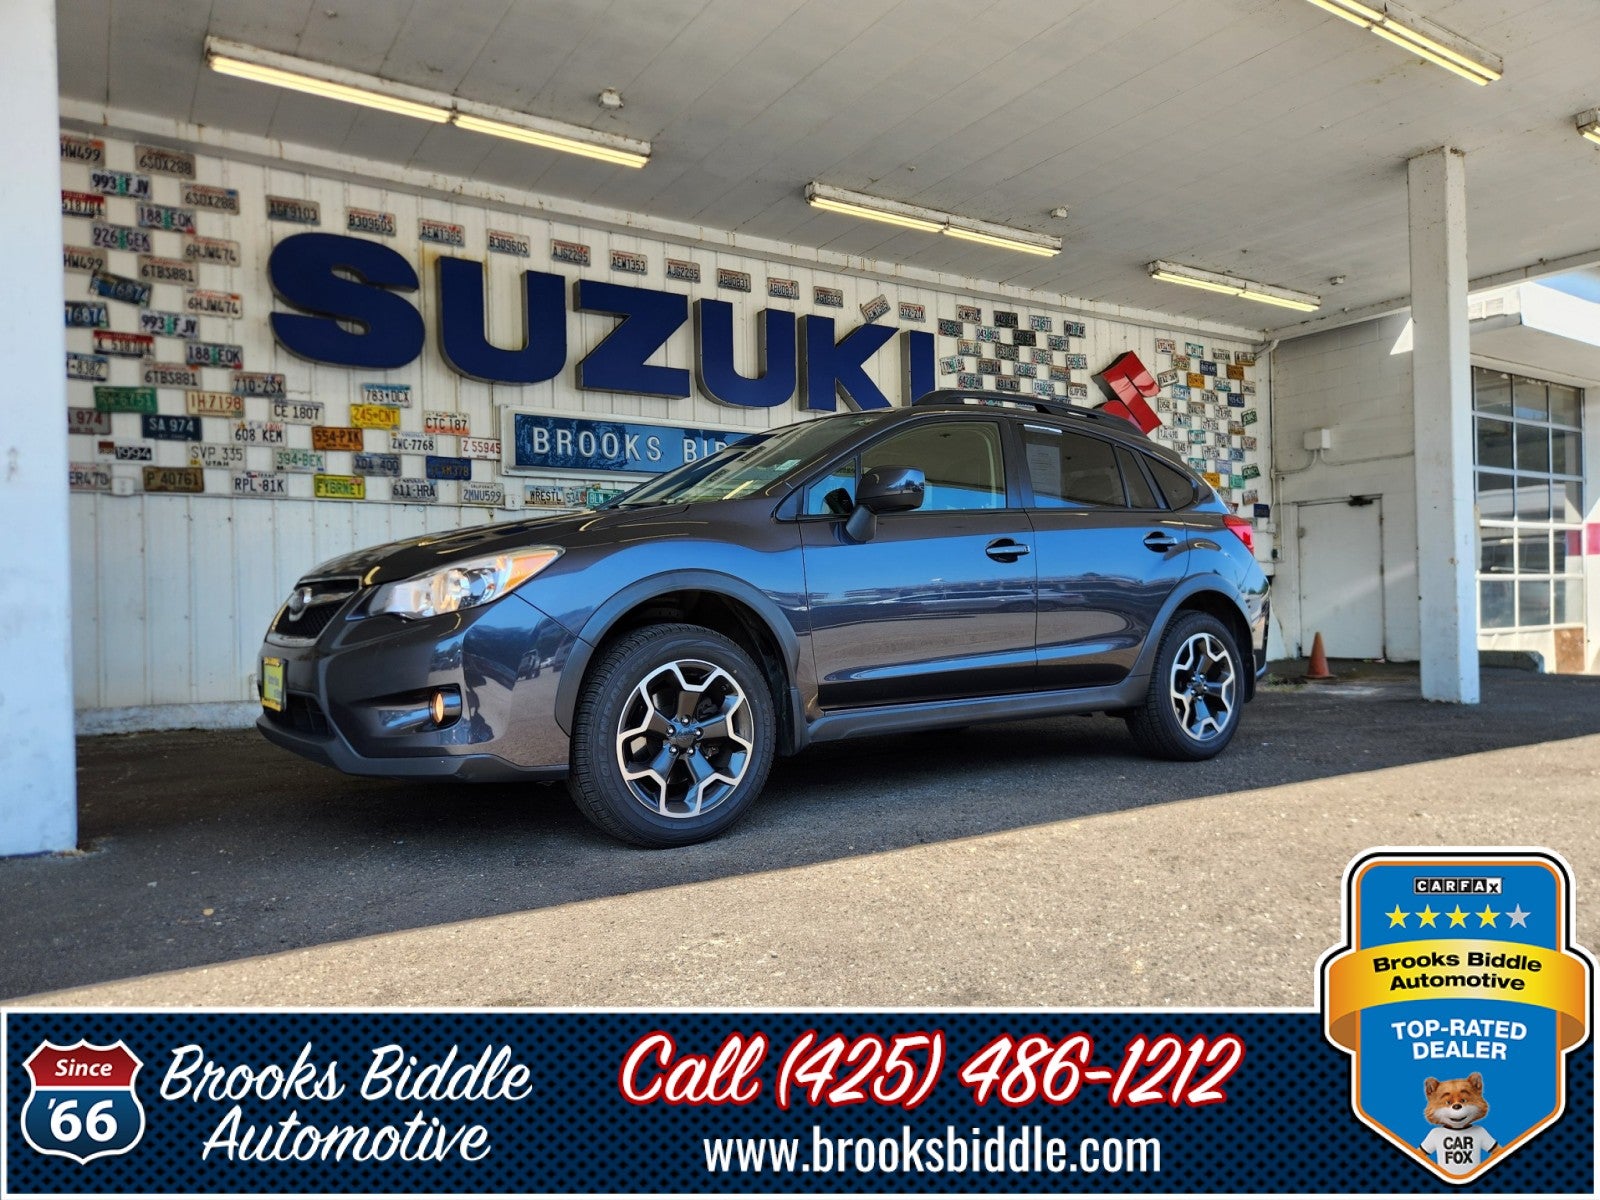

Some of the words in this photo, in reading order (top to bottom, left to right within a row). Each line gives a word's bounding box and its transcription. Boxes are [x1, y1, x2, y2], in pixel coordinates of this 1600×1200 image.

[139, 207, 162, 225] 188
[93, 227, 118, 243] 926
[268, 232, 936, 412] SUZUKI
[187, 346, 210, 362] 188
[273, 404, 288, 418] CE
[148, 416, 166, 432] SA
[168, 417, 195, 433] 974
[425, 417, 446, 430] CTC
[449, 418, 468, 432] 187
[234, 429, 256, 443] 608
[532, 427, 662, 462] BROOKS
[190, 444, 216, 461] SVP
[221, 446, 244, 462] 335
[160, 472, 199, 487] 40761
[529, 490, 562, 502] WRESTL
